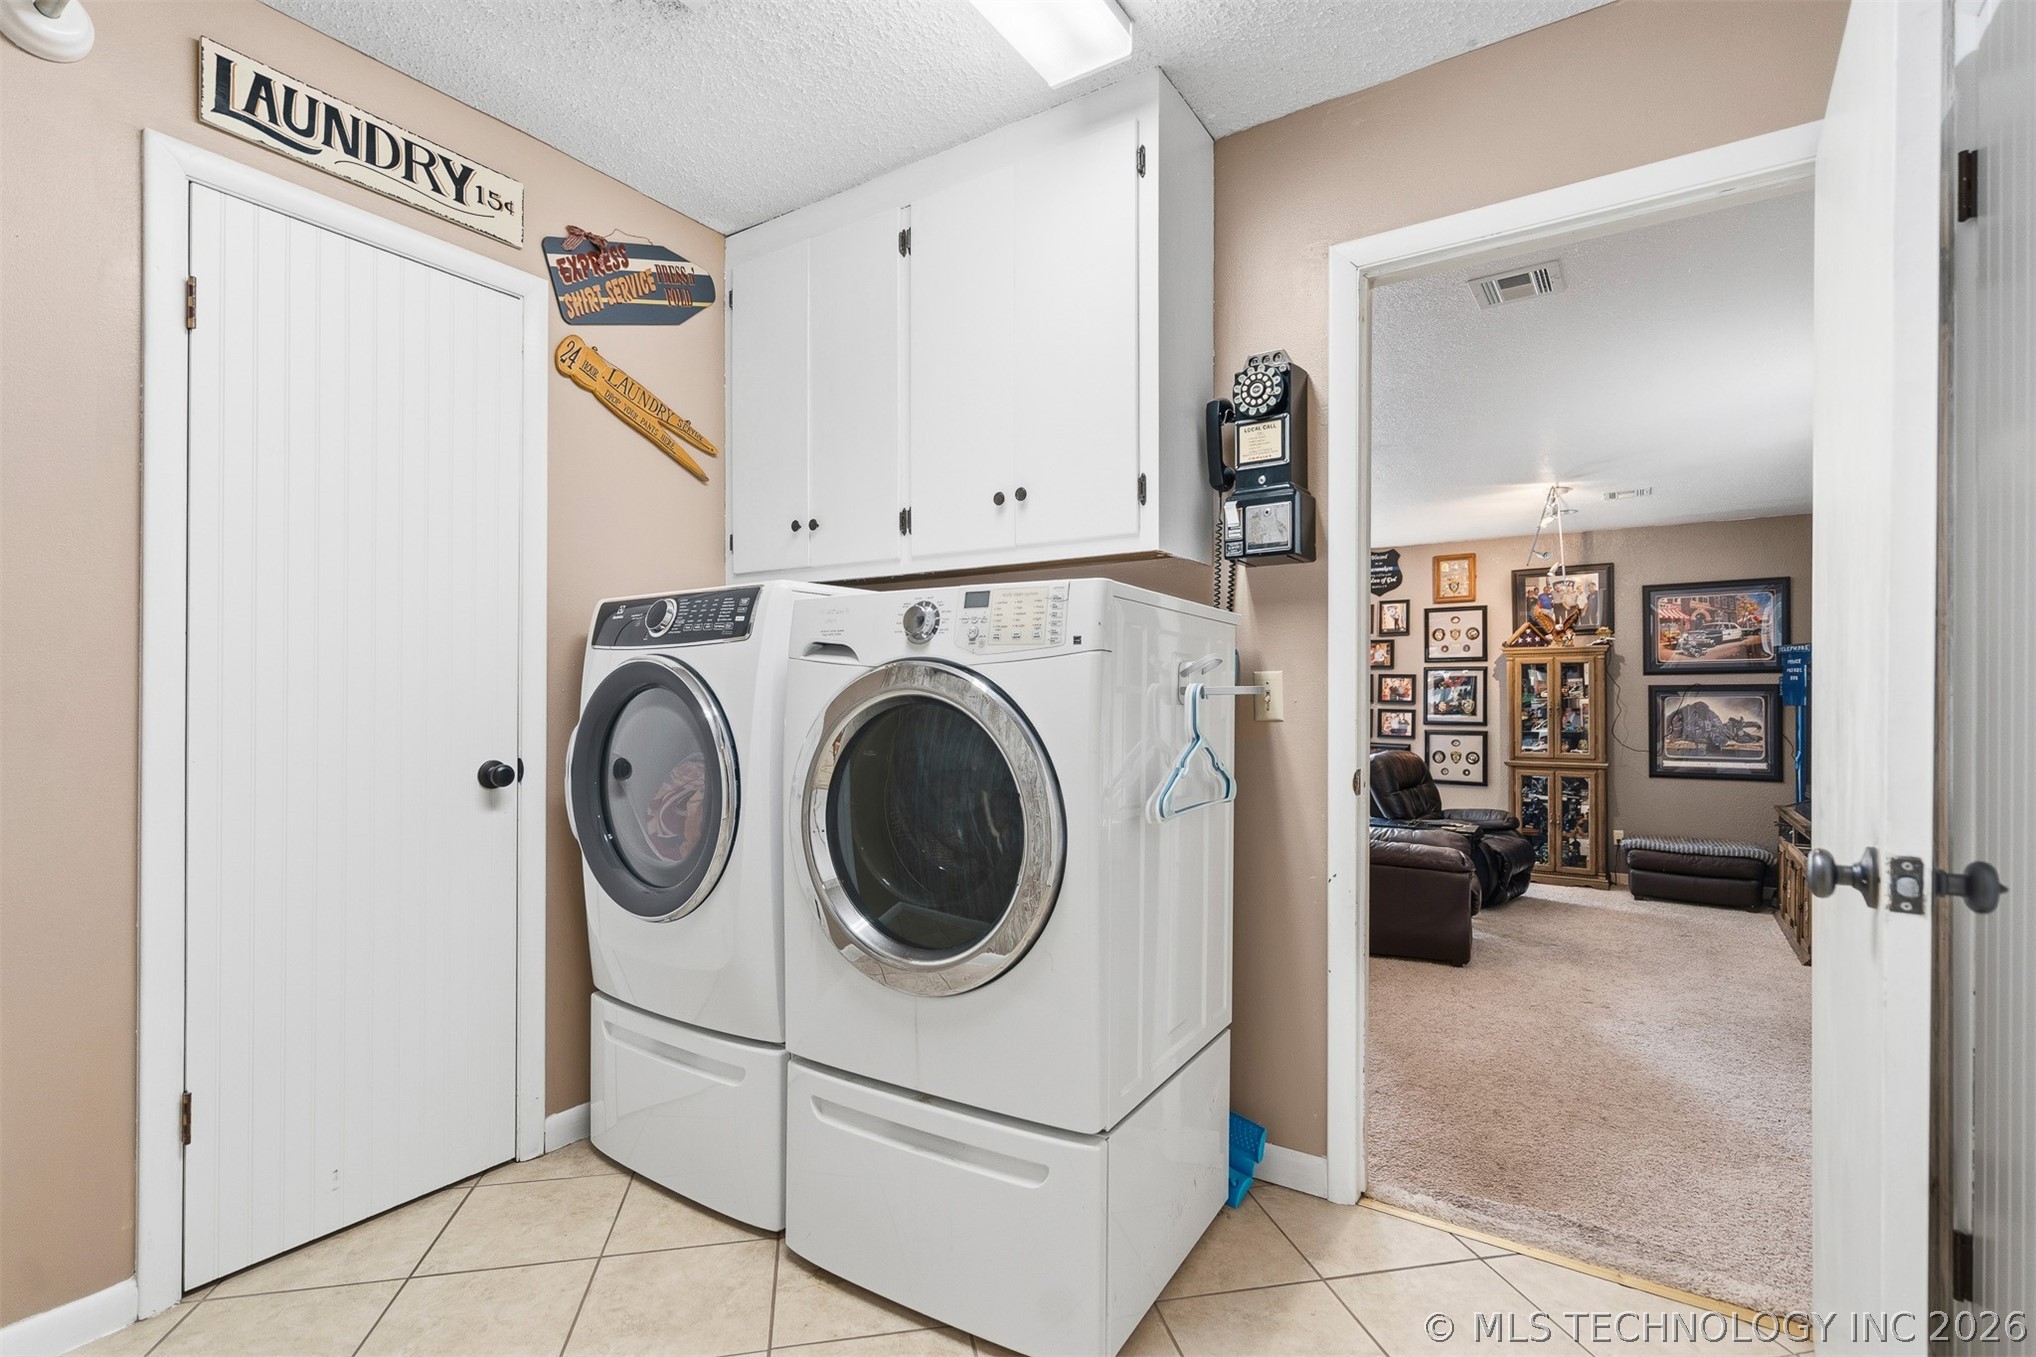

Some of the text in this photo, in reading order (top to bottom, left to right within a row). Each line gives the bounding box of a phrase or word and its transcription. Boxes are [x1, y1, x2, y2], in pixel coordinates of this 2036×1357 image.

[210, 53, 516, 215] LAUNDRY 15¢
[556, 244, 630, 285] EXPRESS
[654, 264, 688, 285] PRESS
[563, 268, 657, 320] SHIRT SERVICE
[666, 287, 693, 307] FOLD
[560, 340, 600, 378] 24 HOUR
[607, 368, 675, 424] LAUNDRY
[604, 389, 676, 450] DROP YOUR PANTS HERE
